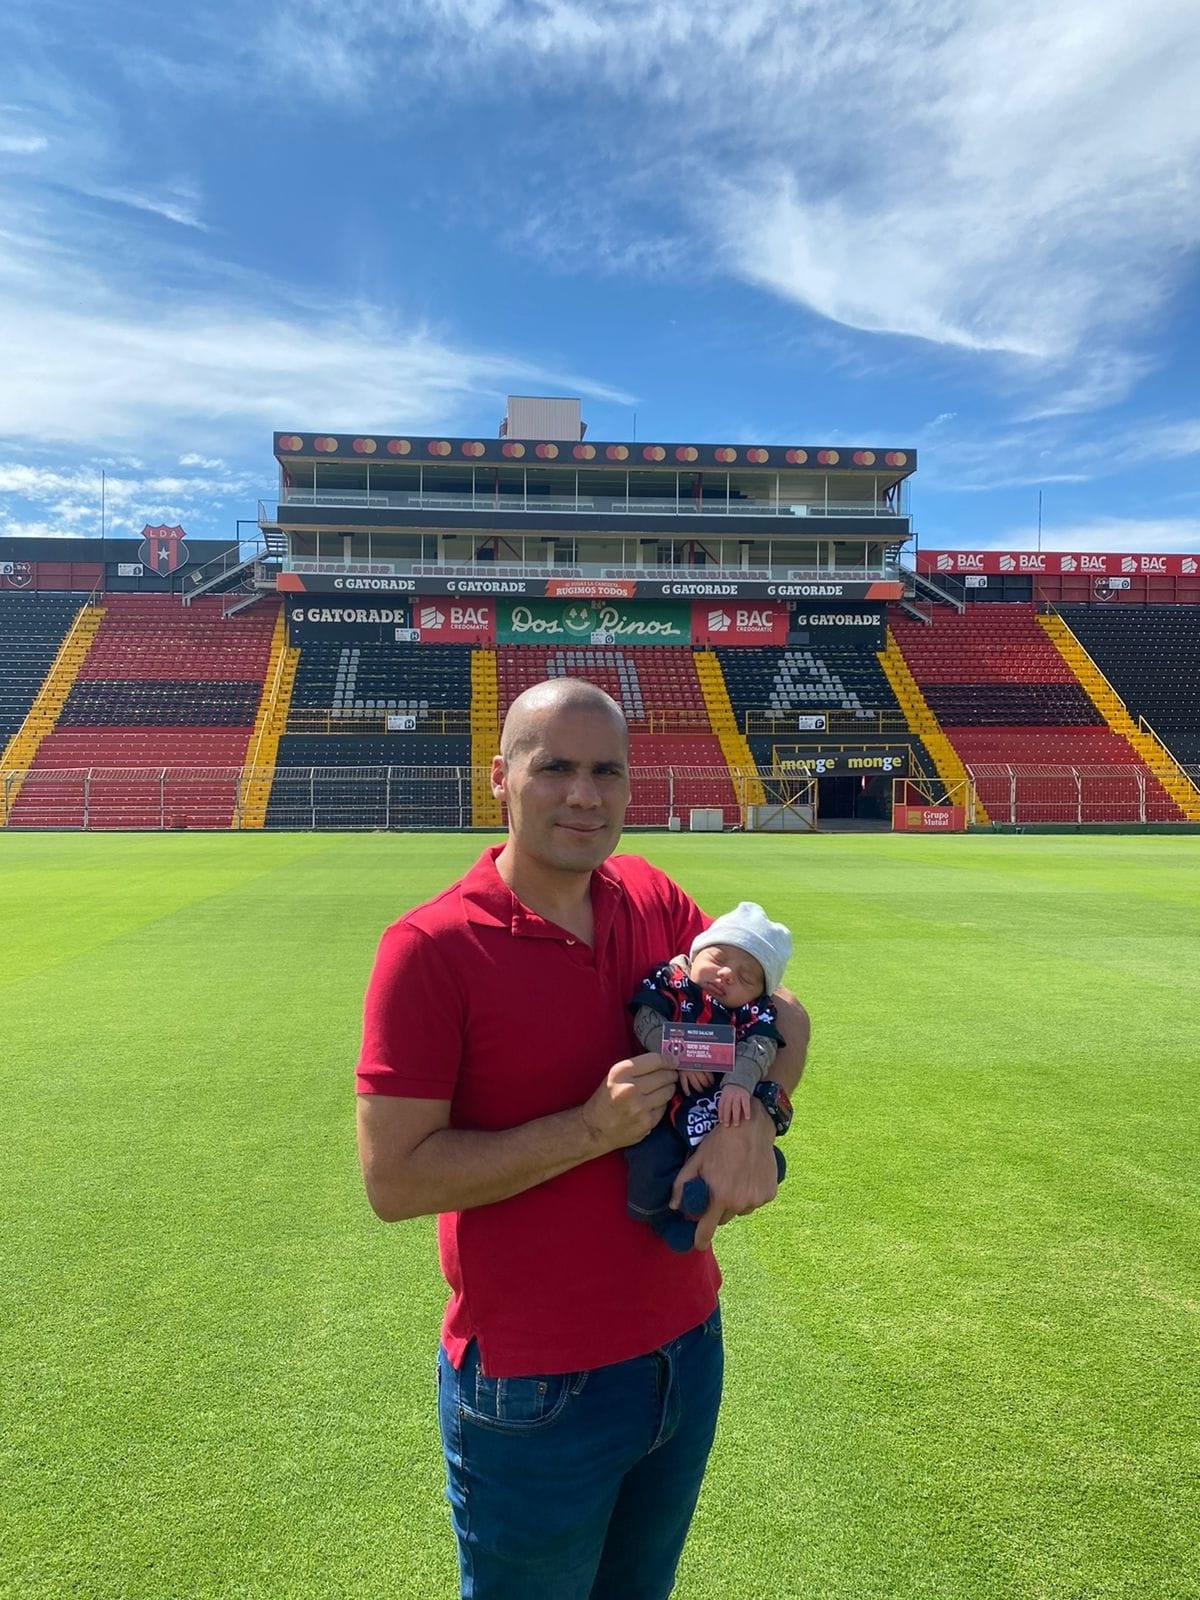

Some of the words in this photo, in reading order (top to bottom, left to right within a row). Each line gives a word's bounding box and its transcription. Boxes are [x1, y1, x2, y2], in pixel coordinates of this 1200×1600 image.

[958, 555, 984, 566] BAC
[1020, 555, 1046, 567] BAC
[1080, 556, 1106, 568] BAC
[1141, 557, 1166, 568] BAC
[346, 579, 416, 590] GATORADE
[458, 582, 526, 592] GATORADE
[672, 584, 738, 595] GATORADE
[556, 587, 596, 596] RUGIMOS
[598, 587, 628, 596] TODOS
[778, 586, 843, 596] GATORADE
[308, 609, 404, 623] GATORADE
[451, 608, 488, 624] BAC
[512, 606, 563, 632] Dos
[596, 607, 680, 635] Pinos
[736, 610, 773, 626] BAC
[810, 615, 880, 626] GATORADE
[782, 758, 835, 772] monge
[848, 756, 901, 771] monge
[924, 810, 949, 821] Grupo
